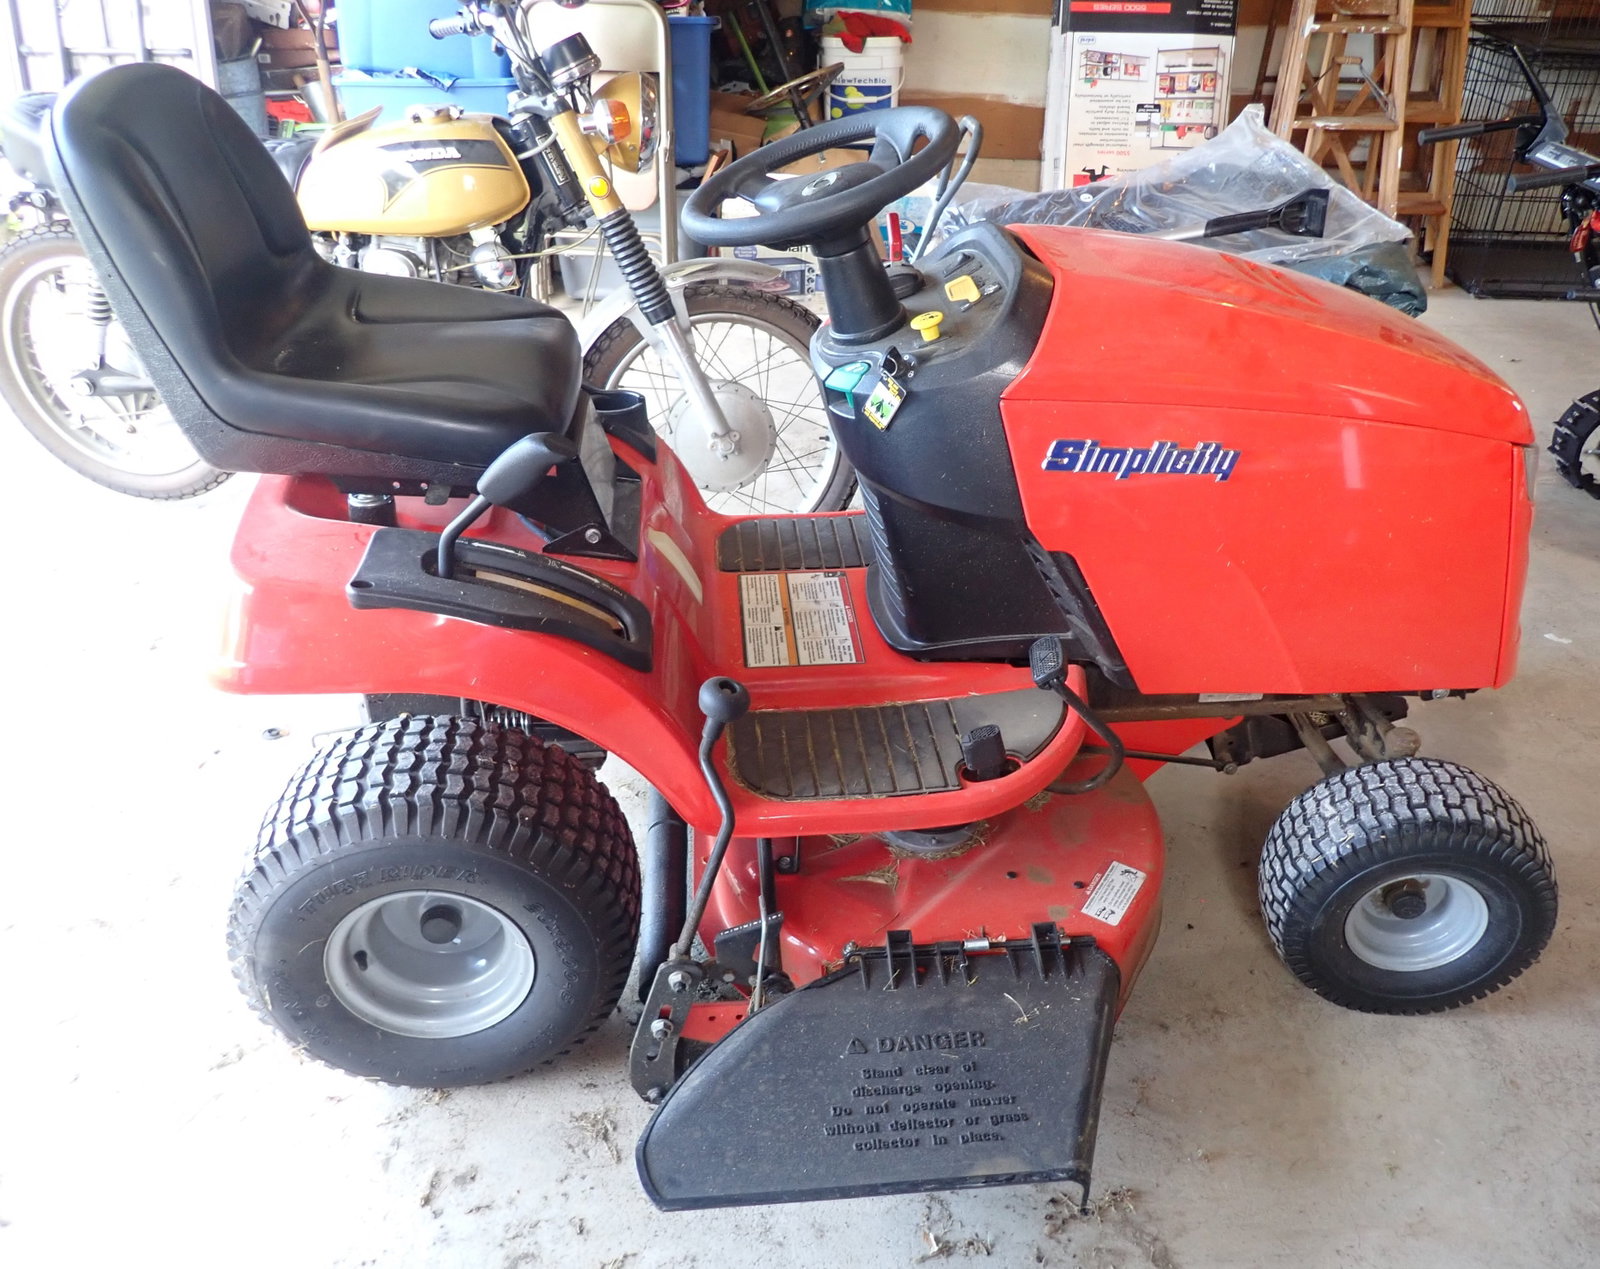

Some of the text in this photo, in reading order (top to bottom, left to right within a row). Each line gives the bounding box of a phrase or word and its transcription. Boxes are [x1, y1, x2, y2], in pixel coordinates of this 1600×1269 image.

[1092, 3, 1148, 12] 5500 SERIES
[834, 76, 888, 85] NewTechBio
[402, 147, 462, 164] ONDA
[1040, 438, 1242, 482] Simplicity
[876, 1030, 987, 1053] DANGER
[861, 1061, 977, 1080] Stand clear of
[852, 1079, 996, 1098] discharge opening.
[831, 1095, 1017, 1118] Do not operate mower
[823, 1111, 1030, 1136] without deflector or grass
[853, 1131, 1005, 1151] collector in place.
